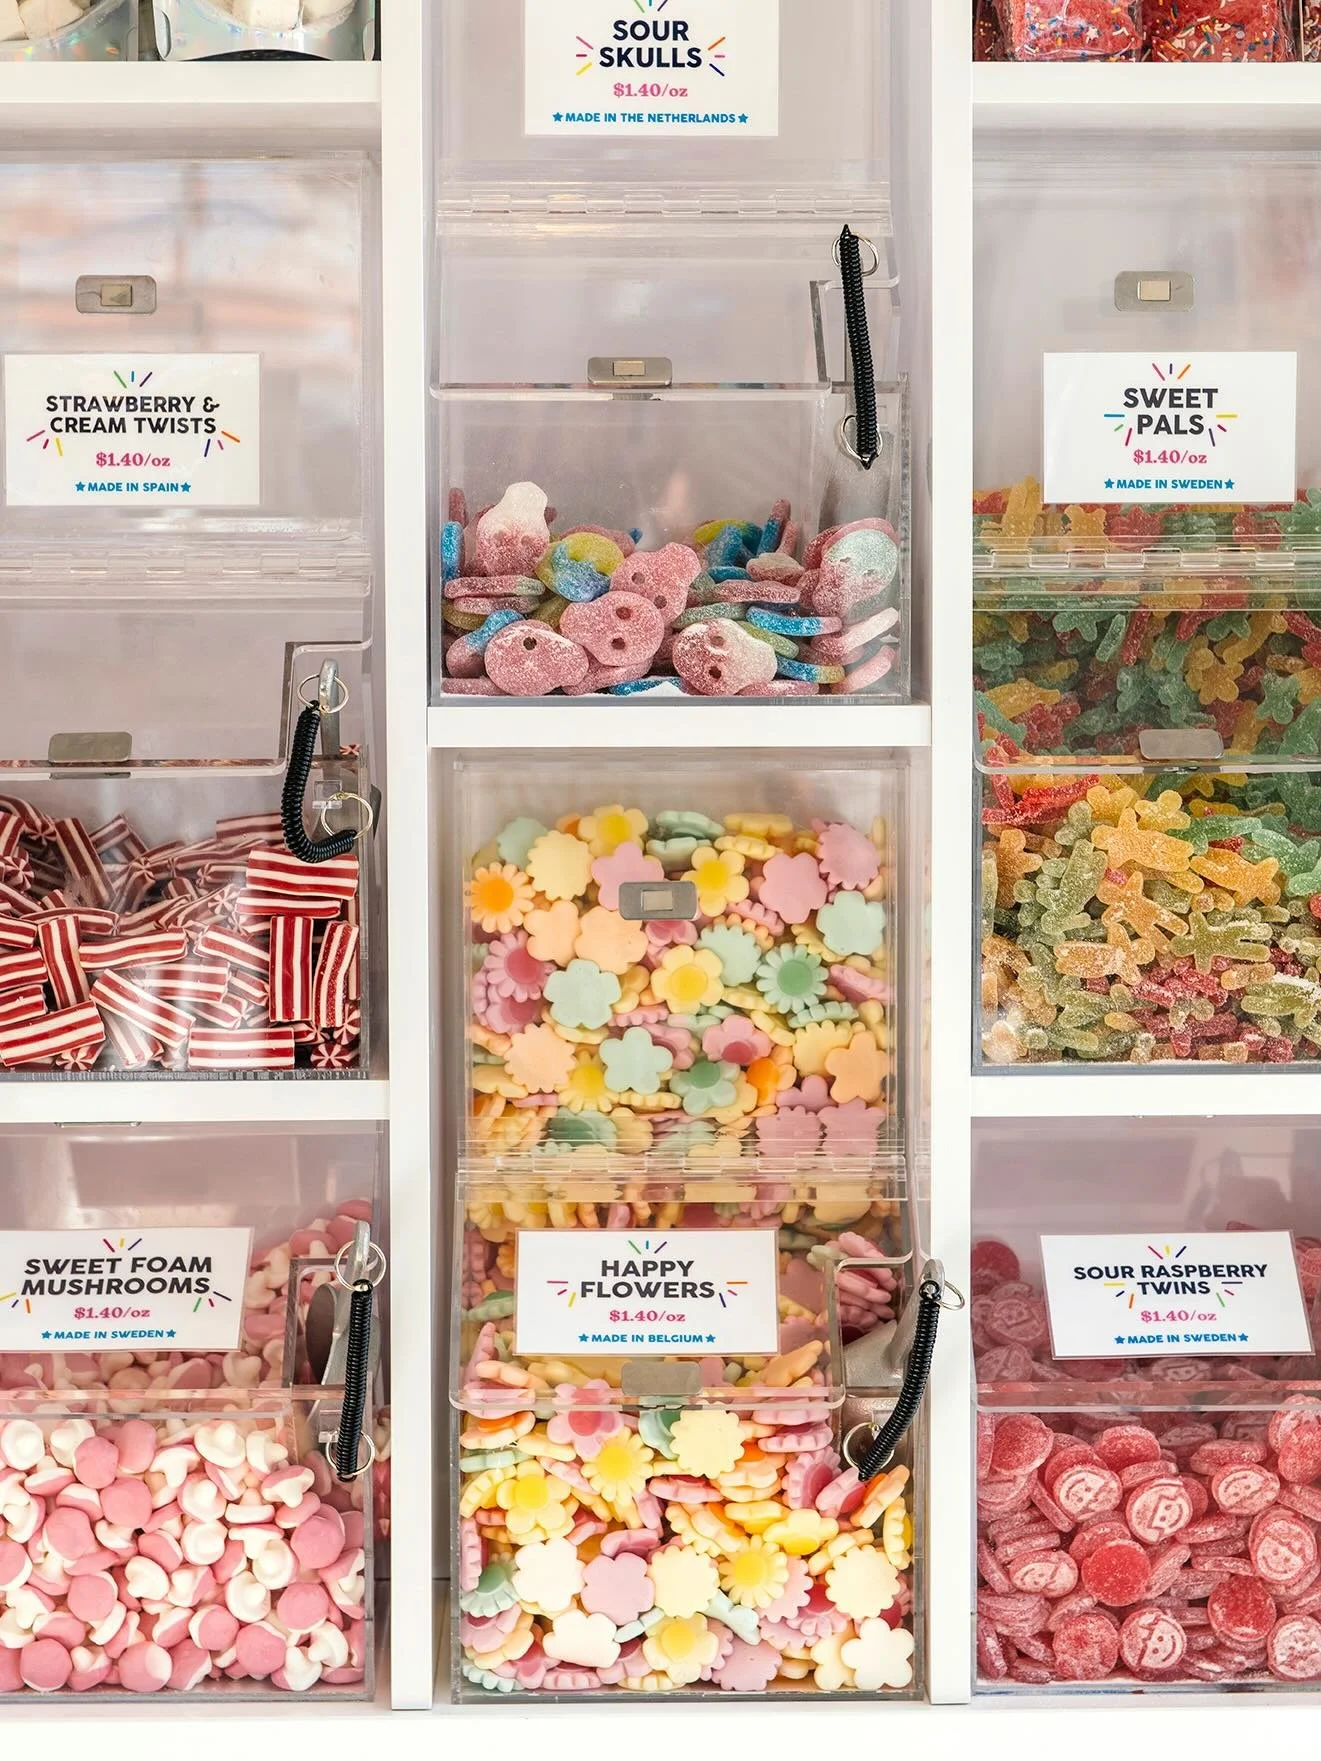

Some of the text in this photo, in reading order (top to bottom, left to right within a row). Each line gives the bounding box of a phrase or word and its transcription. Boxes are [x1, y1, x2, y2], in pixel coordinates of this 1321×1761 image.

[613, 20, 689, 41] SOUR
[599, 47, 702, 68] SKULLS
[614, 83, 688, 97] $1.40/oz
[566, 113, 735, 123] MADE IN THE NETHERLANDS
[46, 396, 220, 413] STRAWBERRY &
[1124, 388, 1218, 408] SWEET
[50, 417, 216, 434] CREAM TWISTS
[1138, 415, 1204, 435] PALS
[96, 452, 170, 467] $1.40/oz
[1134, 449, 1207, 465] $1.40/oz
[88, 483, 178, 492] MADE IN SPAIN
[1117, 480, 1222, 489] MADE IN SWEDEN
[24, 1257, 211, 1275] SWEET FOAM
[602, 1260, 694, 1277] HAPPY
[1074, 1264, 1267, 1280] SOUR RASPBERRY
[21, 1277, 209, 1295] MUSHROOMS
[581, 1282, 715, 1298] FLOWERS
[1137, 1281, 1210, 1295] TWINS
[74, 1307, 150, 1320] $1.40/oz
[610, 1310, 685, 1322] $1.40/oz
[1141, 1310, 1216, 1323] $1.40/oz
[54, 1331, 90, 1339] MADE
[111, 1330, 164, 1338] SWEDEN
[1128, 1335, 1163, 1344] MADE
[1184, 1334, 1236, 1342] SWEDEN
